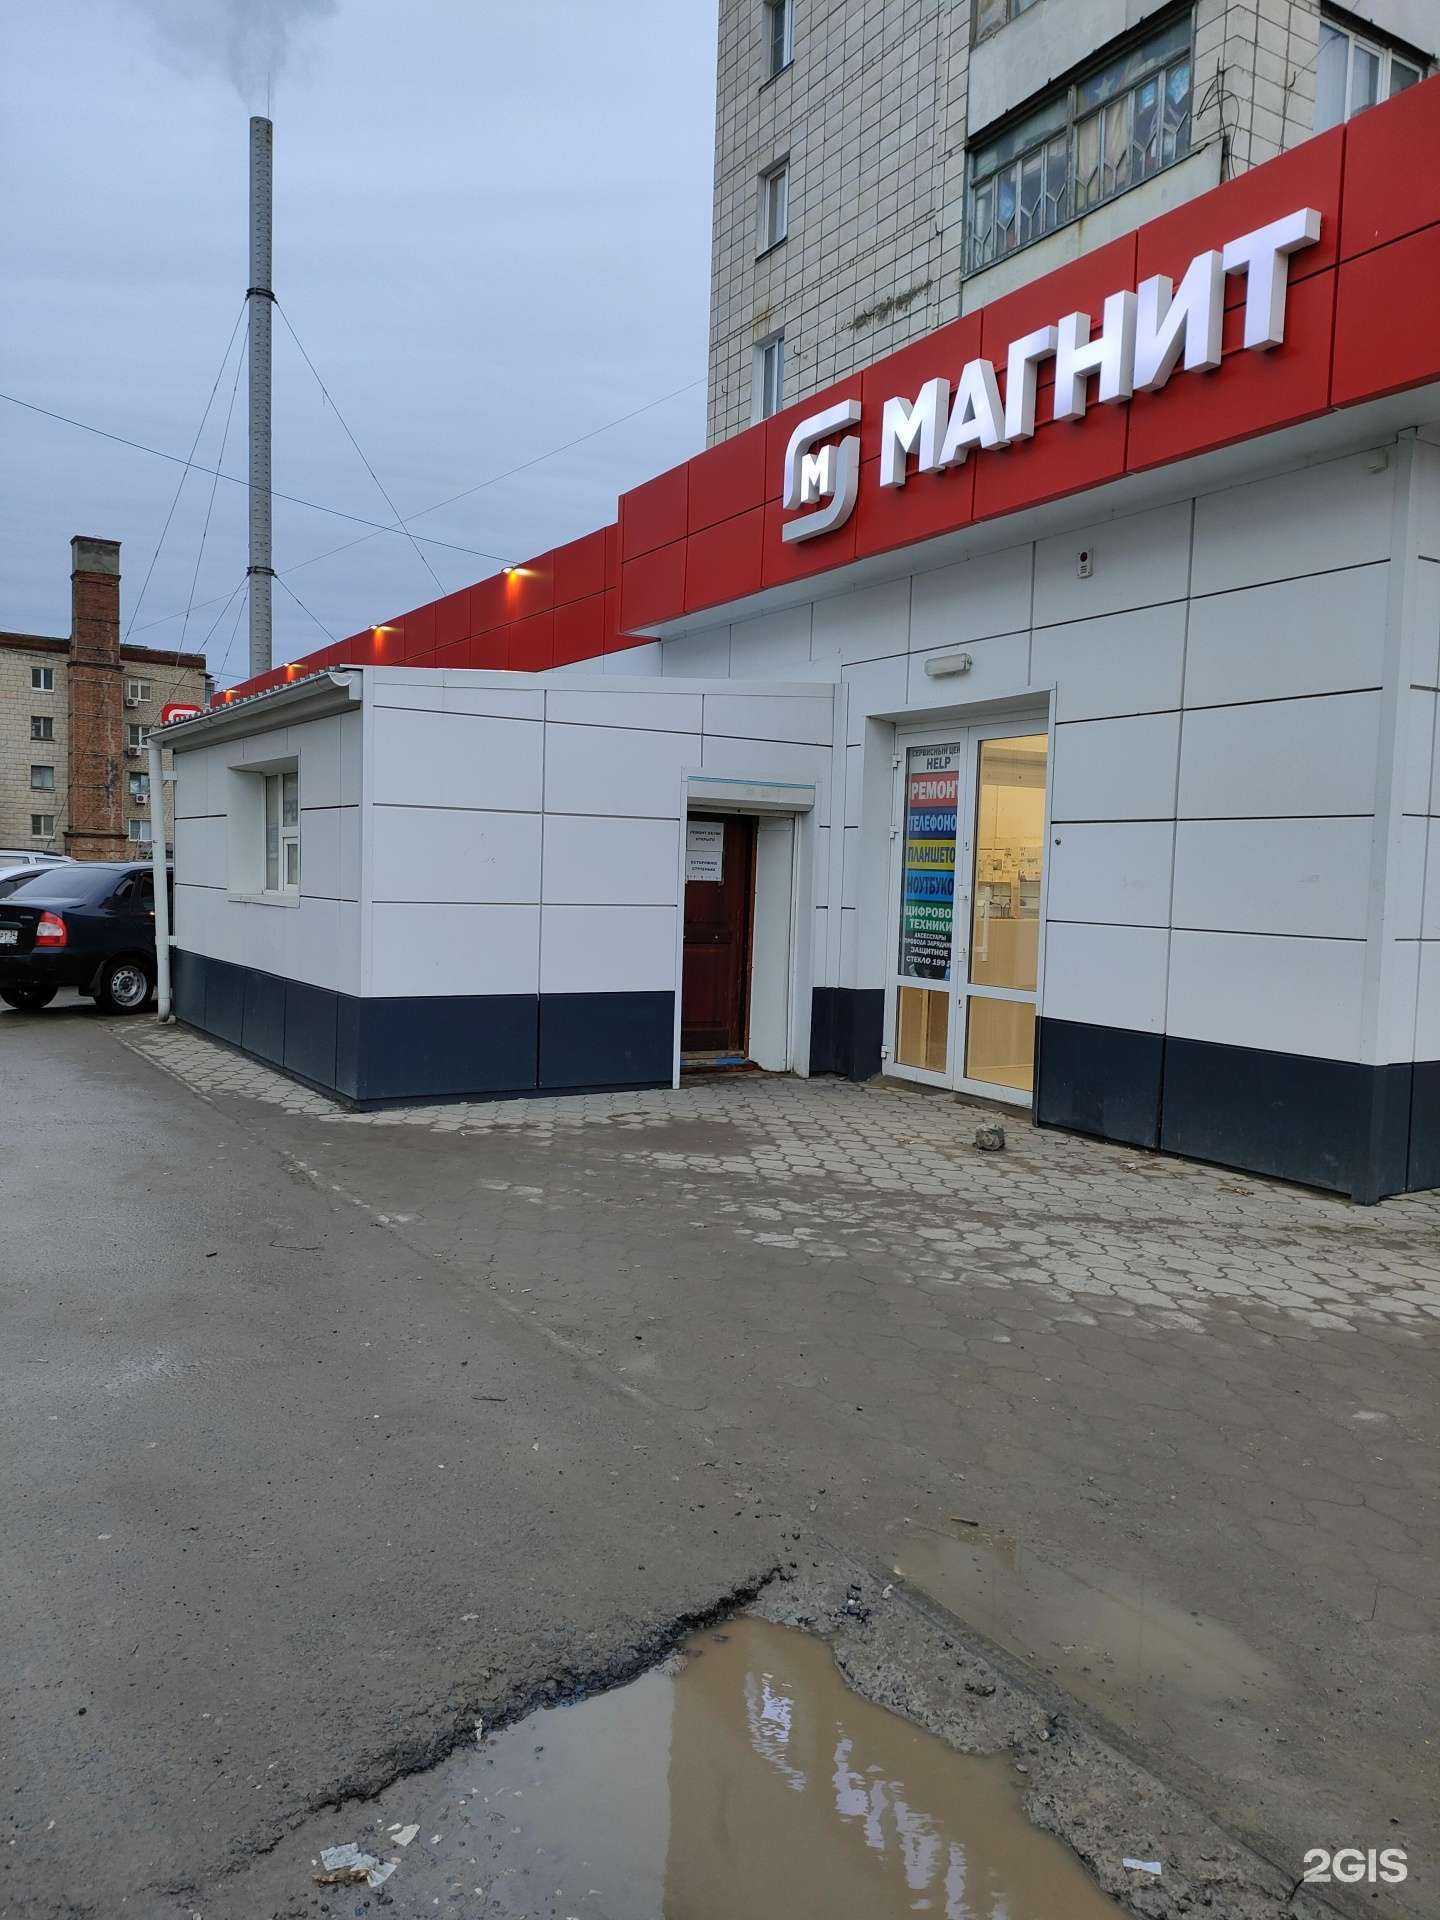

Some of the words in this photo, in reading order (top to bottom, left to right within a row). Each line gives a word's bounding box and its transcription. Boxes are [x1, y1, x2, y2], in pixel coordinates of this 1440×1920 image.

[880, 207, 1322, 488] МАГНИТ
[926, 756, 951, 770] HELP
[911, 780, 958, 800] РЕМОН
[909, 814, 957, 832] ТЕЛЕФОНО
[905, 905, 953, 919] ЦИФРОВО
[910, 918, 953, 932] ТЕХНИКИ
[910, 946, 949, 957] ЗАЩИТНОЕ
[906, 955, 931, 965] СТЕКЛО
